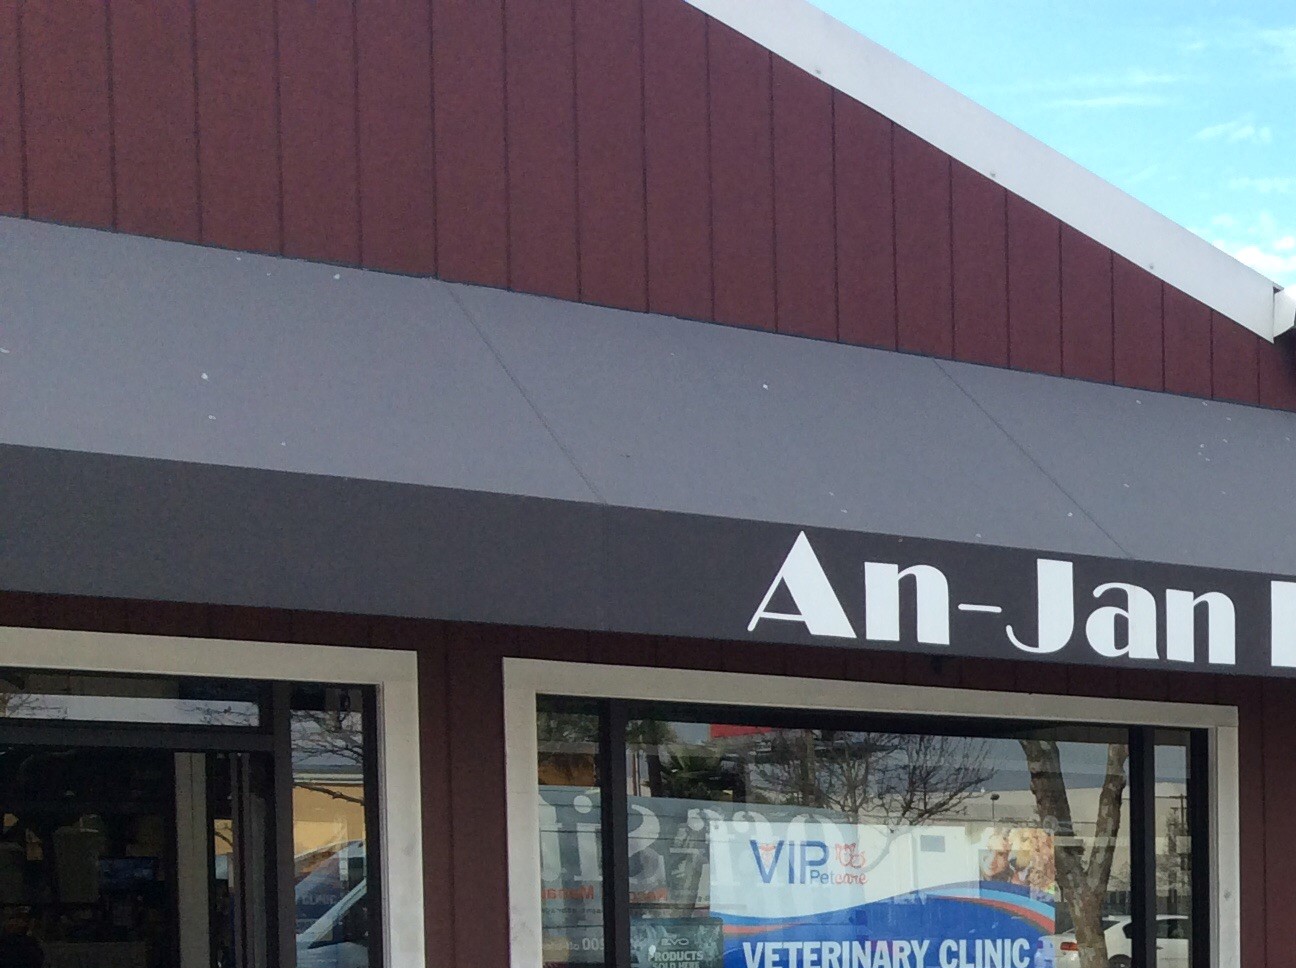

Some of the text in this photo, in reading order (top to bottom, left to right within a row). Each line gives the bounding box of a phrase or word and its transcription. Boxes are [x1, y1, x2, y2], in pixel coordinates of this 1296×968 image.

[748, 531, 1235, 664] An-Jan
[749, 839, 830, 884] VIP
[648, 950, 704, 962] PRODUCTS
